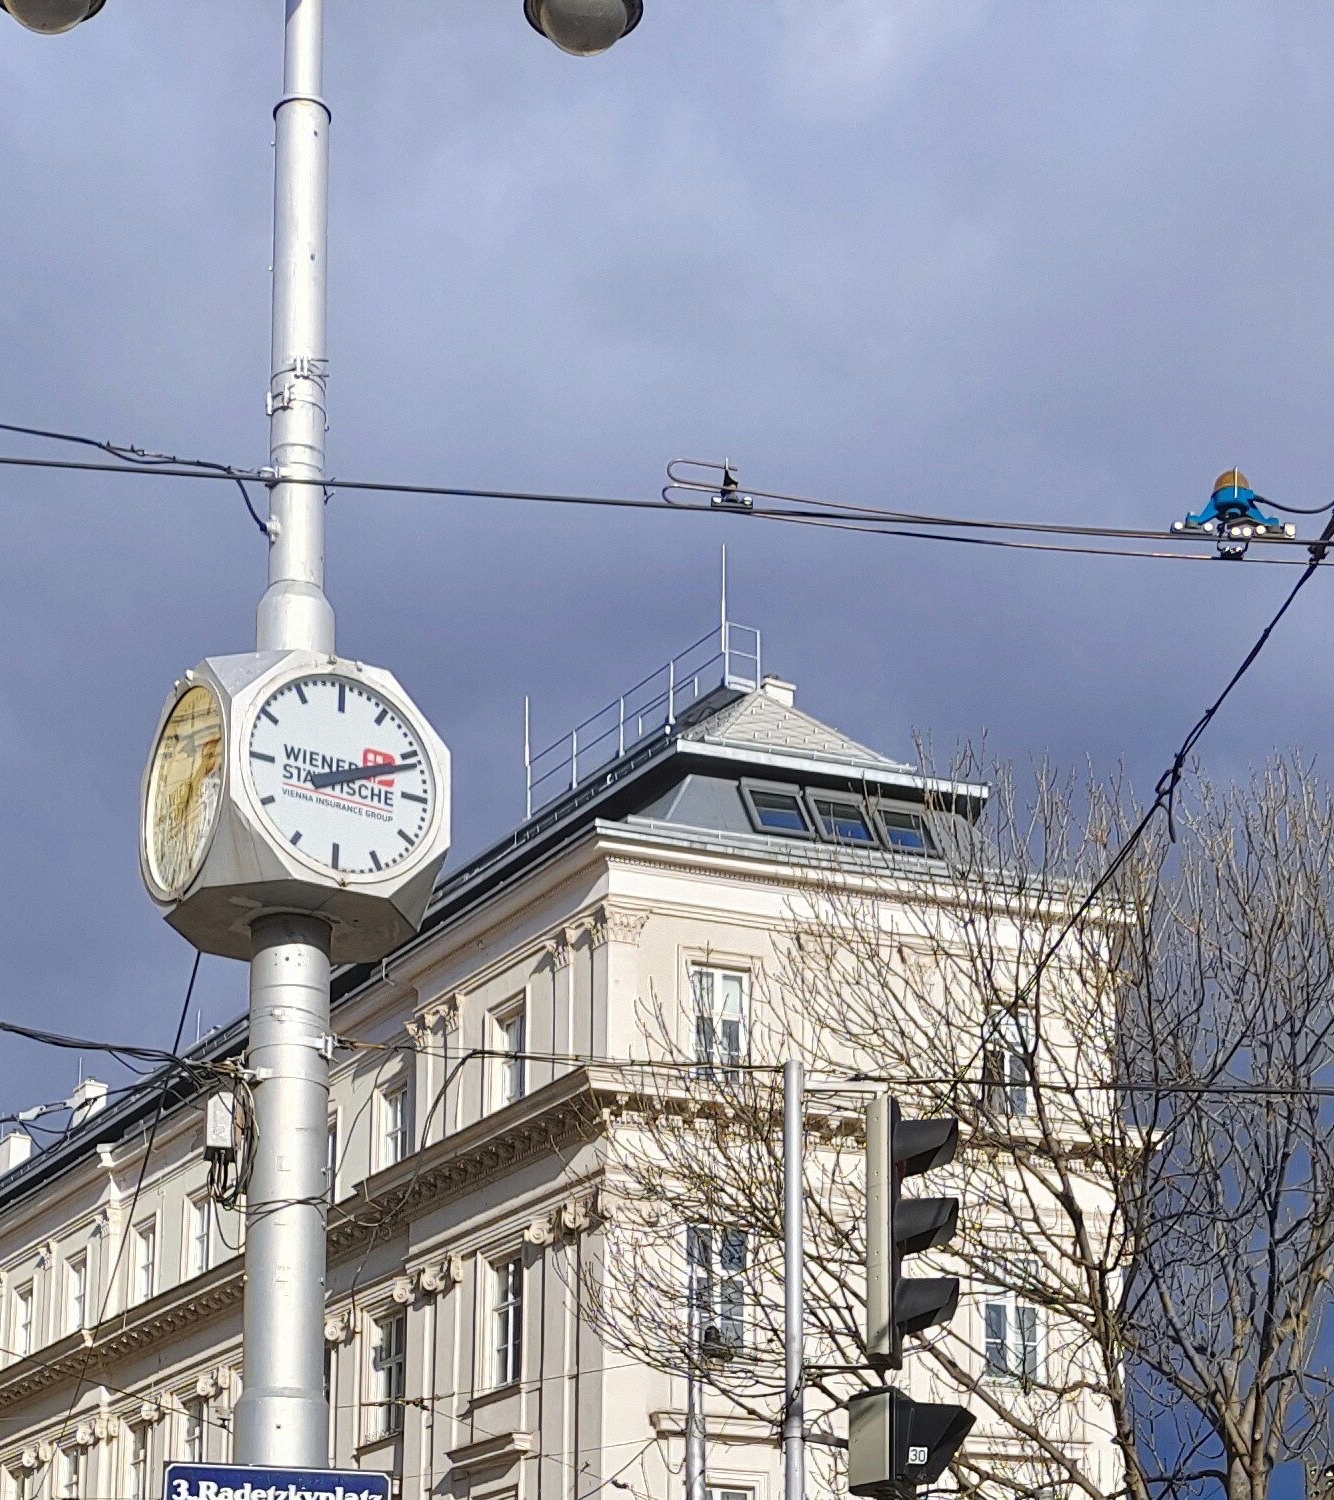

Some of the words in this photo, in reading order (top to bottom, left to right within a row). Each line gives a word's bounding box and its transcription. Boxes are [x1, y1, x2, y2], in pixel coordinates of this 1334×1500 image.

[283, 763, 394, 807] STÄISCHE
[282, 787, 314, 803] VIENNA
[315, 795, 363, 816] INSURANCE
[365, 809, 394, 822] GROUP
[910, 1449, 925, 1462] 30
